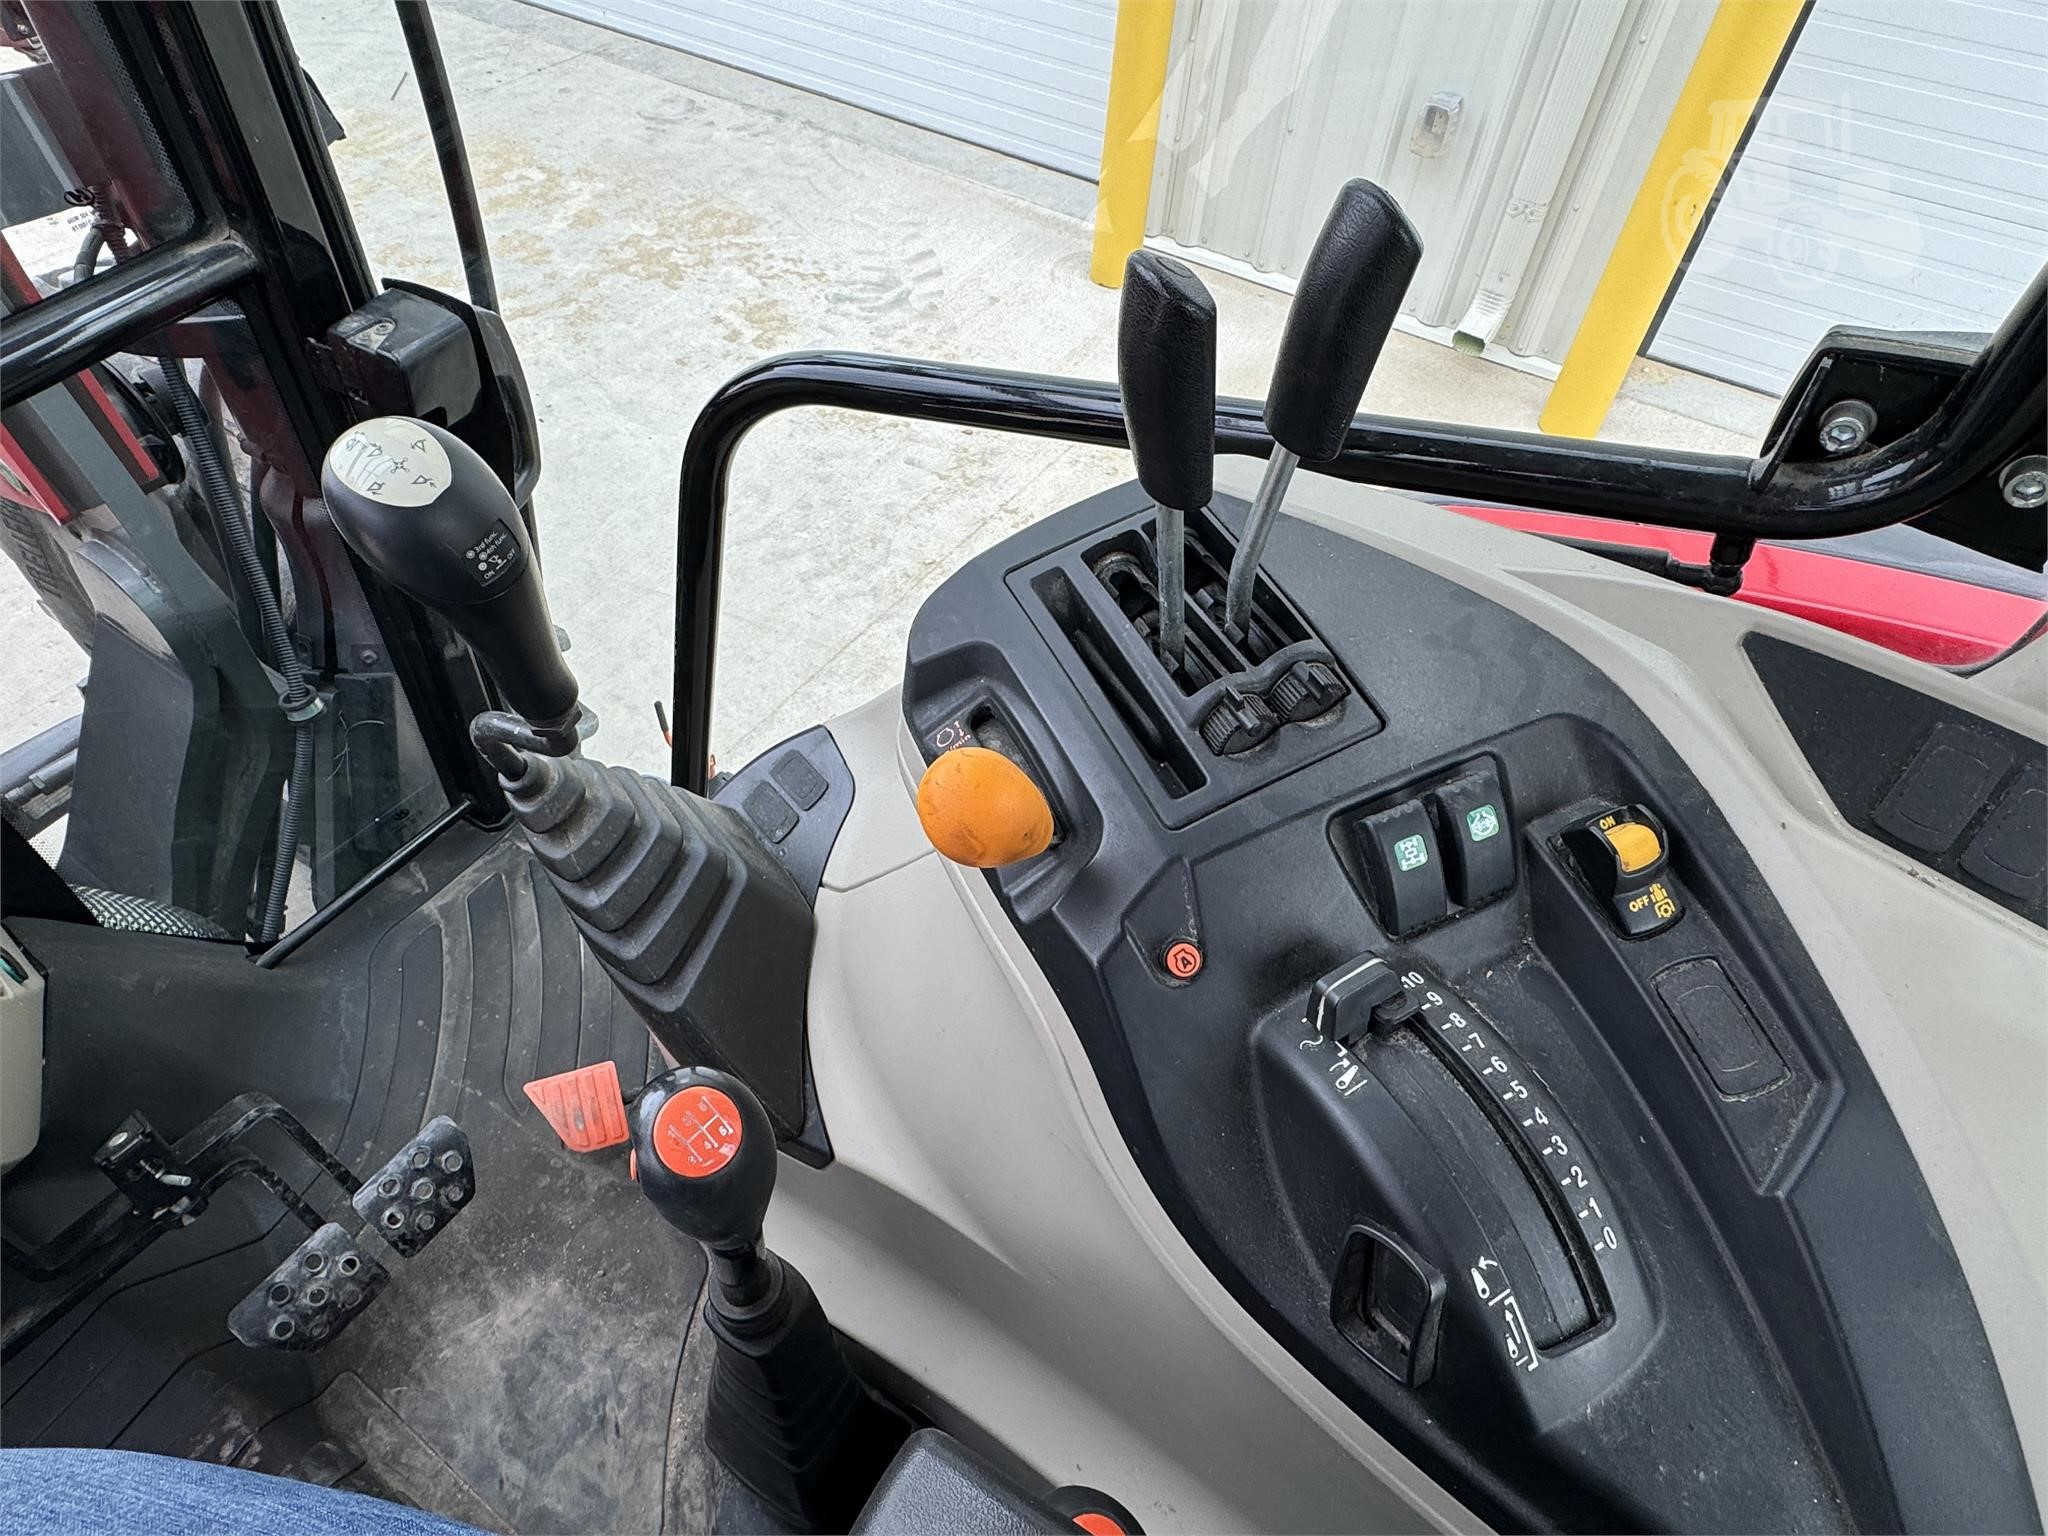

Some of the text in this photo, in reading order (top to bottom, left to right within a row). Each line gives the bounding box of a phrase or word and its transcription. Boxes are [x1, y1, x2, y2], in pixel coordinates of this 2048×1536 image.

[1600, 816, 1616, 829] ON
[1629, 895, 1649, 912] OFF
[1181, 956, 1192, 969] A
[1401, 971, 1424, 988] 10
[1426, 991, 1443, 1006] 9
[1448, 1012, 1466, 1029] 8
[1467, 1032, 1486, 1049] 7
[1490, 1055, 1508, 1073] 6
[1509, 1080, 1529, 1099] 5
[1534, 1106, 1549, 1125] 4
[1551, 1135, 1568, 1155] 3
[1570, 1165, 1588, 1188] 2
[1588, 1196, 1603, 1219] 1
[1603, 1226, 1618, 1250] 0
